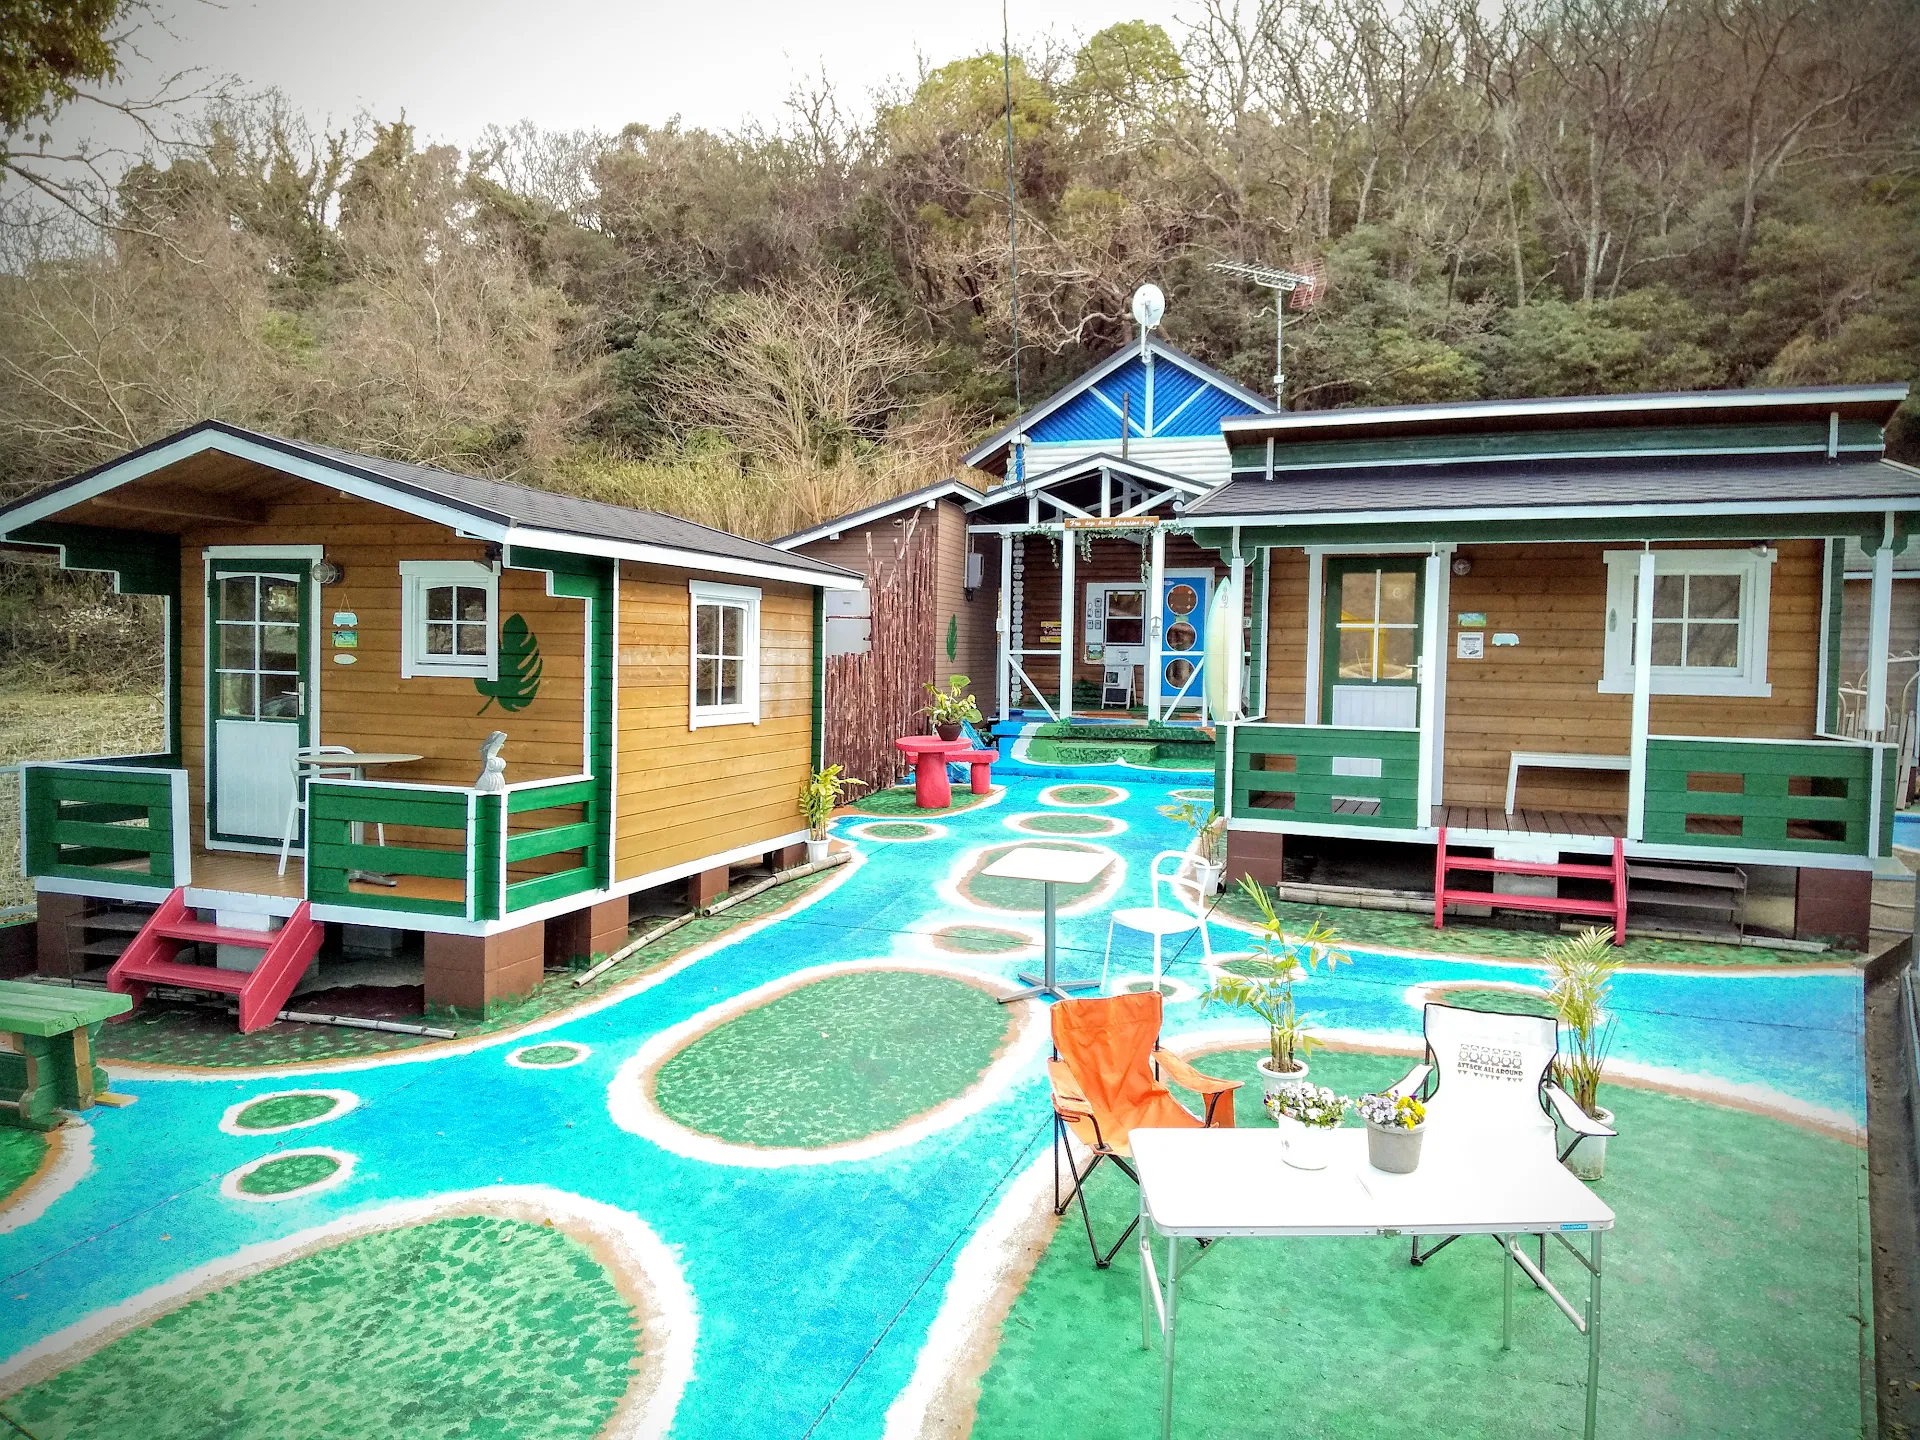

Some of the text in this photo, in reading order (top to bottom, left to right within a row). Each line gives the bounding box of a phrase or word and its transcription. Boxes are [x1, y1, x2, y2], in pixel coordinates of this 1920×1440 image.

[277, 593, 286, 607] B
[1457, 1061, 1524, 1077] ATTACK ALL AROUND
